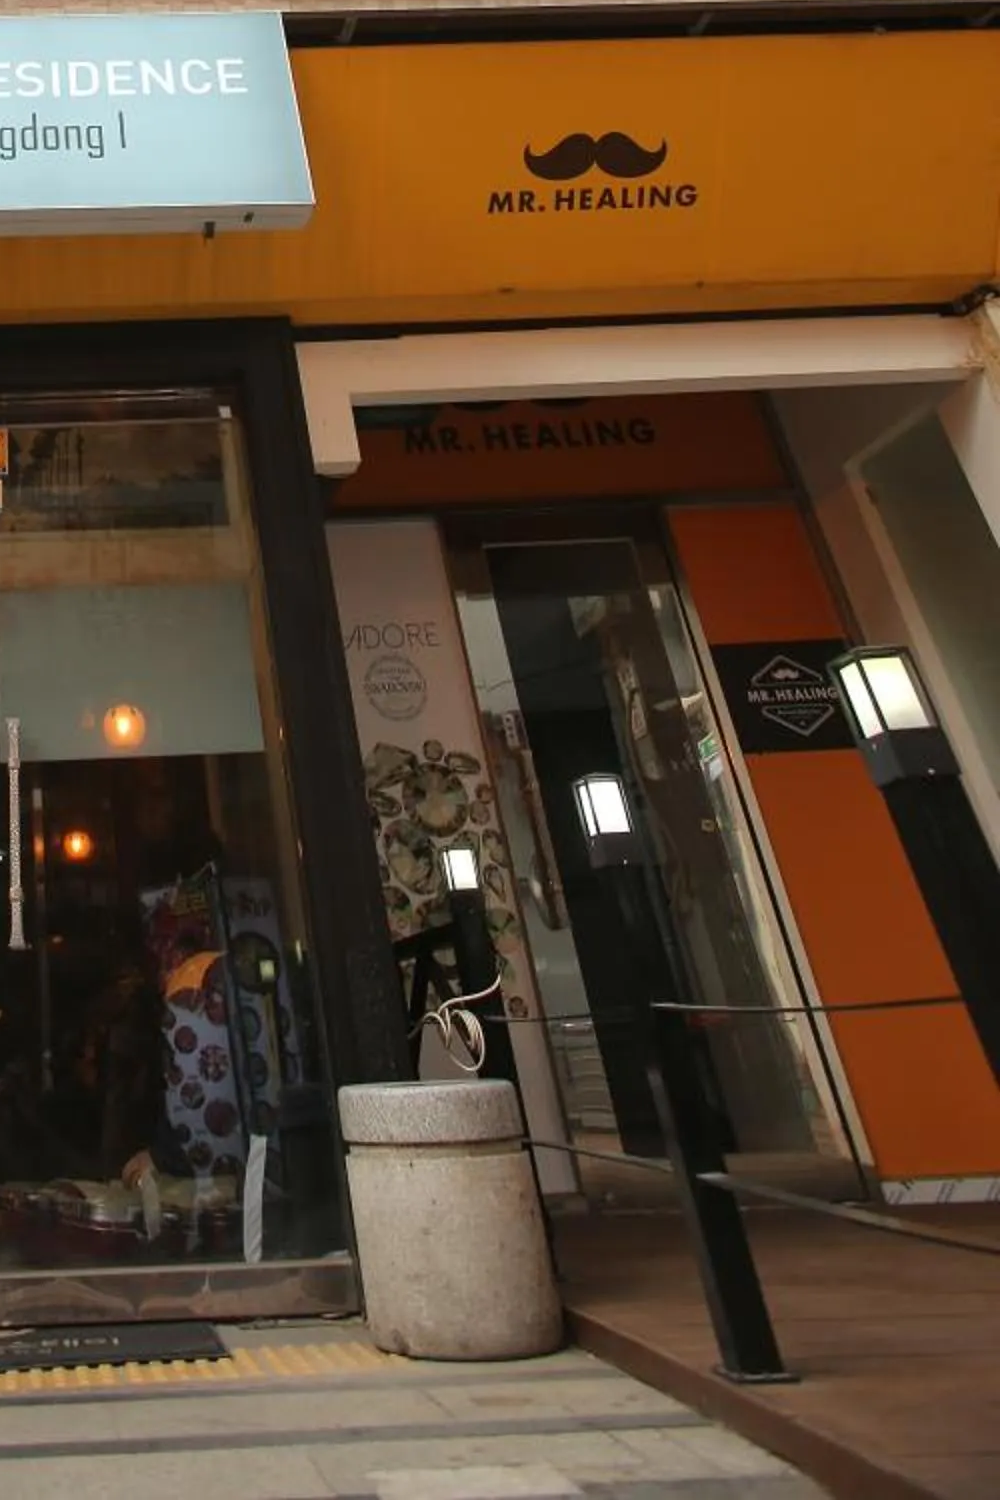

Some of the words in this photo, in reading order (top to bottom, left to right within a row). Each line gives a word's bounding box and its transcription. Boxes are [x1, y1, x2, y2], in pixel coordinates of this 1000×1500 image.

[487, 190, 545, 214] MR.
[553, 184, 698, 211] HEALING
[404, 427, 474, 454] MR.
[481, 418, 656, 449] HEALING
[748, 691, 774, 703] MR.
[777, 687, 837, 701] HEALING
